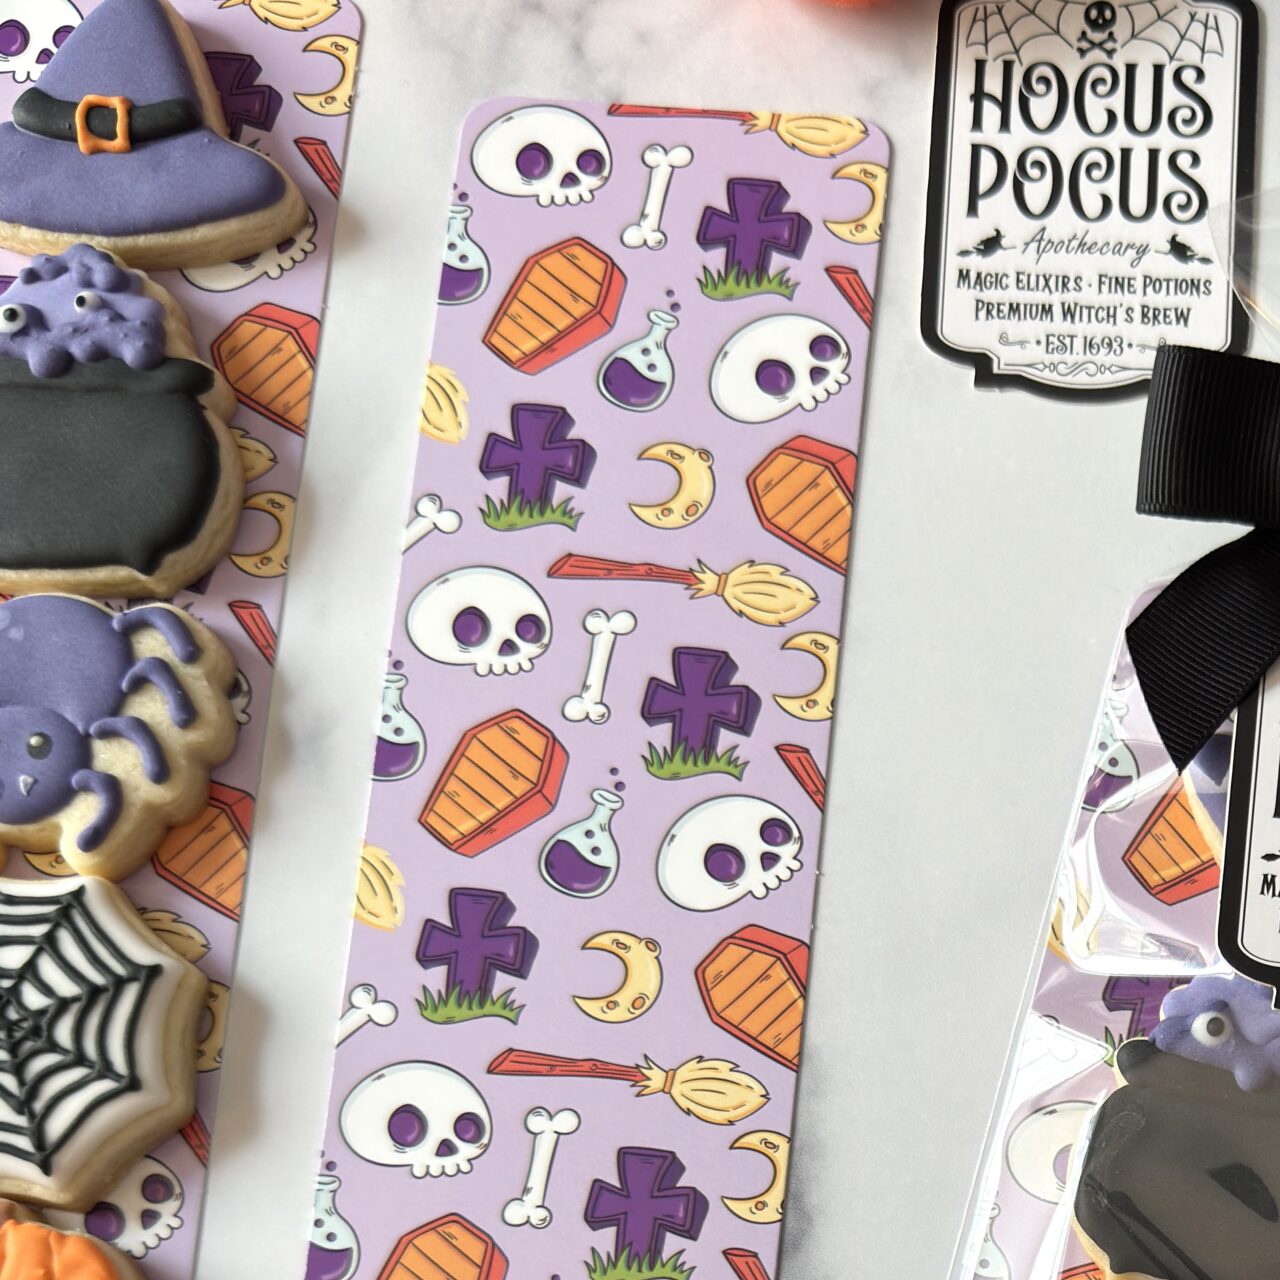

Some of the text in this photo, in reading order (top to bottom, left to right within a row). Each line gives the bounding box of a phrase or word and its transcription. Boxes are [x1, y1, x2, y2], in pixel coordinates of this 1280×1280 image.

[969, 59, 1213, 138] HOCUS
[966, 143, 1209, 225] POCUS
[1022, 226, 1152, 268] Apothecary
[956, 269, 1212, 298] MAGIC ELIXIRS FINE POTIONS
[974, 299, 1192, 328] PREMIUM WITCH'S BREW
